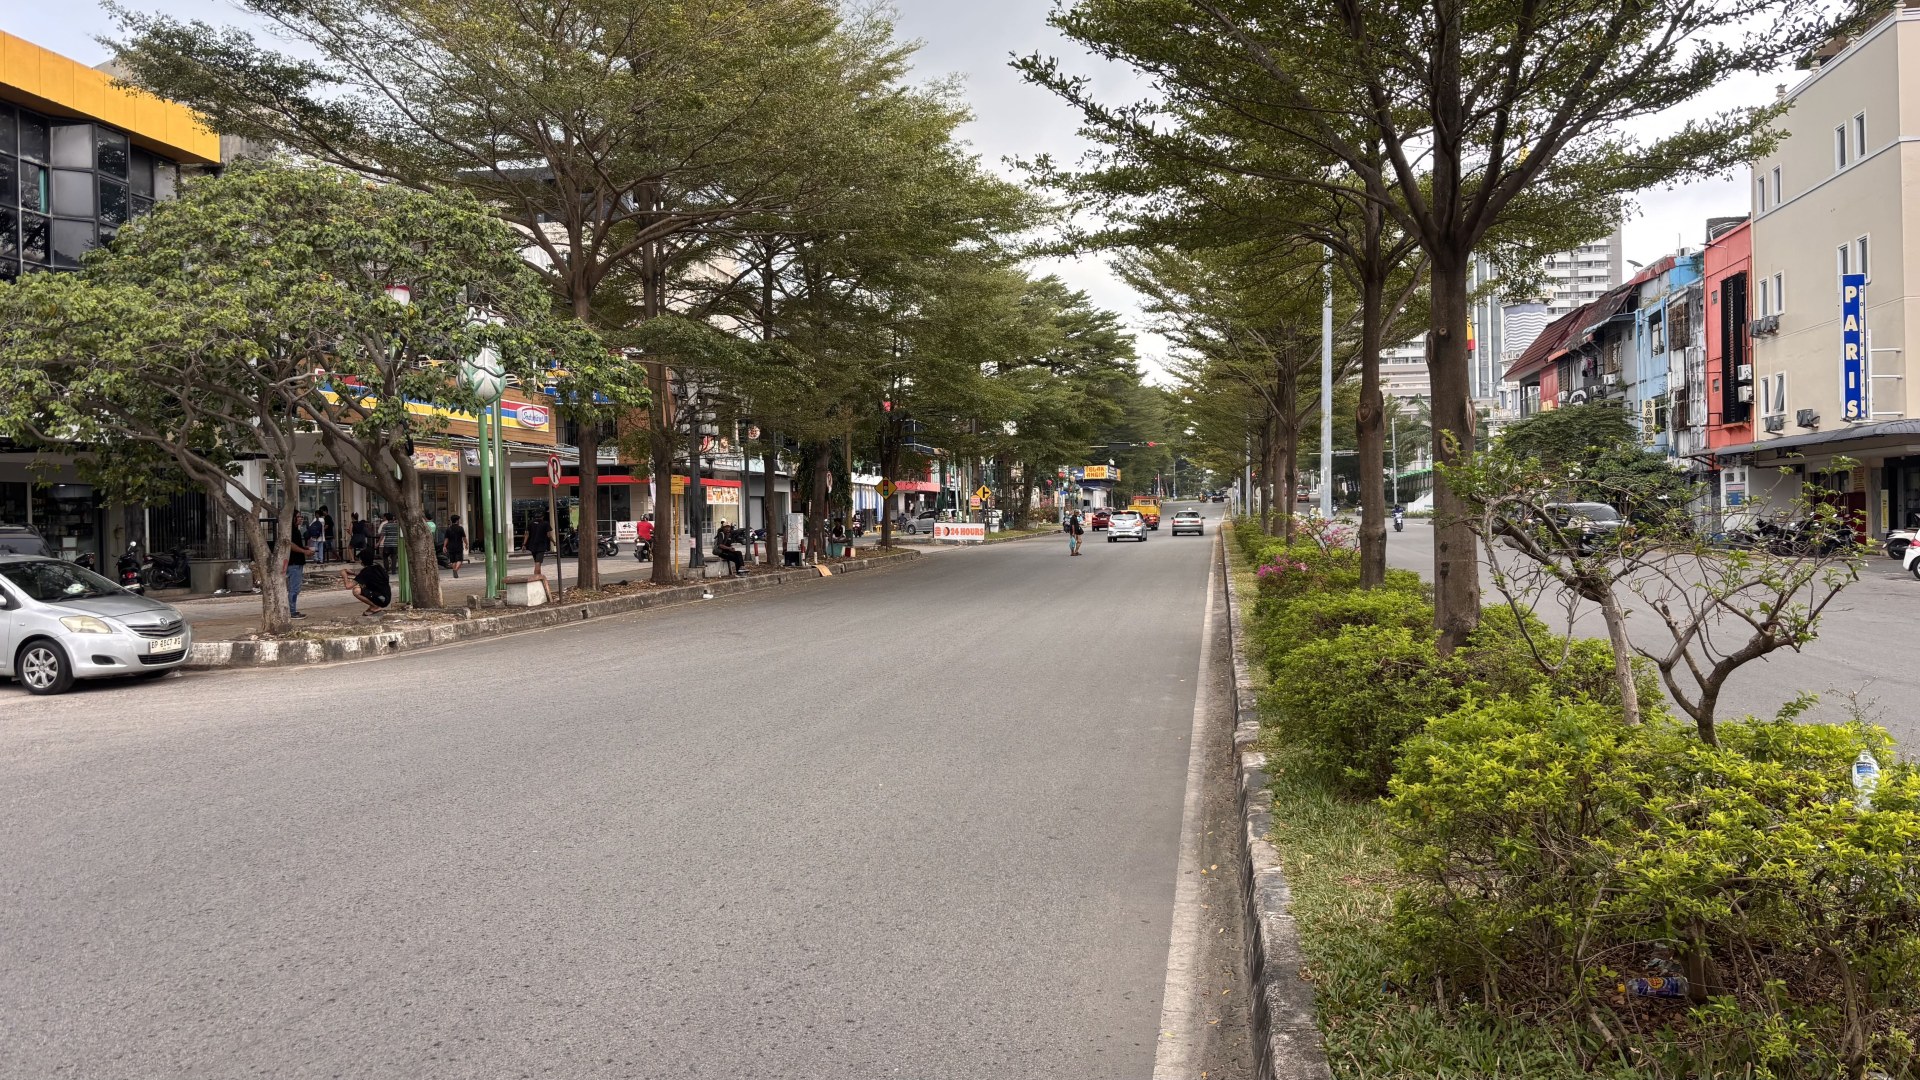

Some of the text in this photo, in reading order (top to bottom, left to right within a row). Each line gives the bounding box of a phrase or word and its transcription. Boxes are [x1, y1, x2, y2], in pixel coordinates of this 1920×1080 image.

[1844, 285, 1858, 418] PARIS
[1645, 400, 1653, 440] RAWON
[950, 528, 959, 536] 24
[960, 528, 984, 536] HOURS
